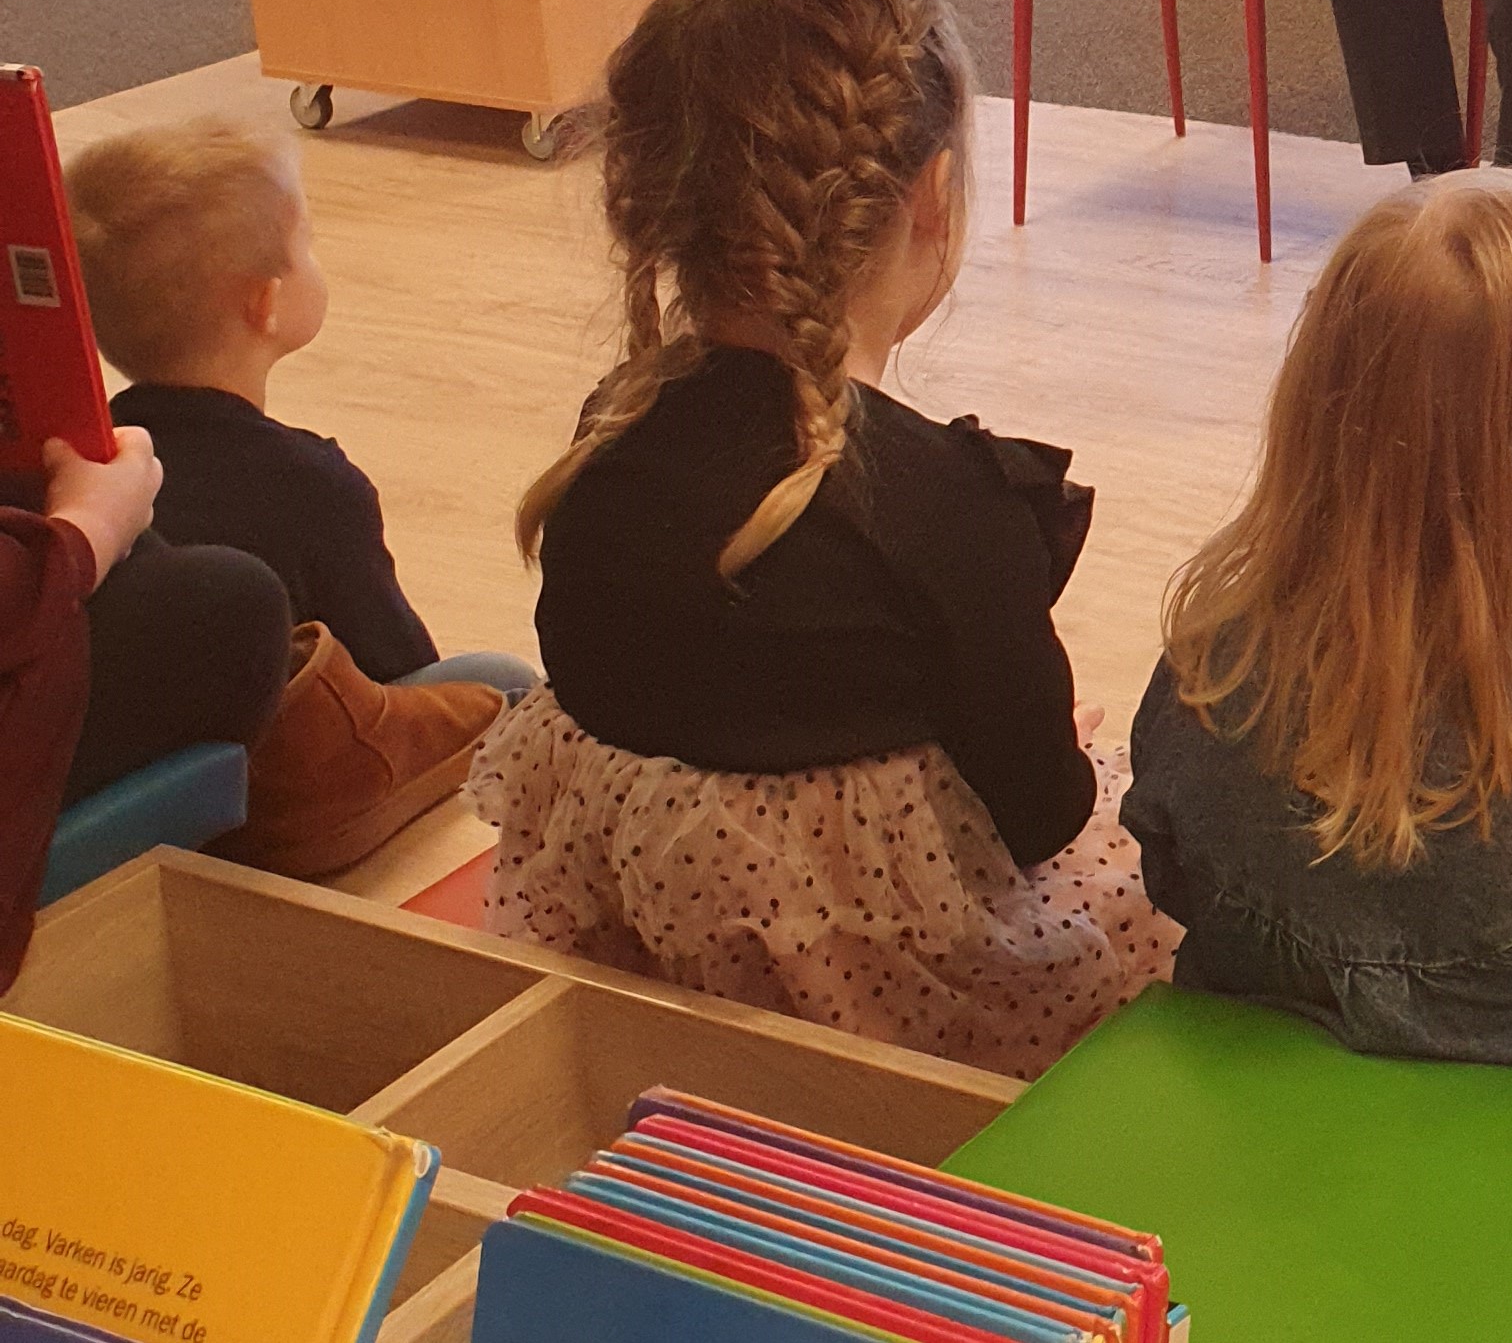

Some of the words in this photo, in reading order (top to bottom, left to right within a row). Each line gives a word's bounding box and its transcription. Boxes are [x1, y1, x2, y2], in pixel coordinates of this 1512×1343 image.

[2, 1218, 39, 1250] dag.
[45, 1229, 105, 1269] Varken
[108, 1252, 125, 1276] is
[123, 1258, 173, 1296] jarig.
[176, 1274, 203, 1301] Ze
[59, 1277, 79, 1301] te
[82, 1284, 138, 1323] vieren
[141, 1308, 180, 1336] met
[182, 1318, 207, 1343] de
